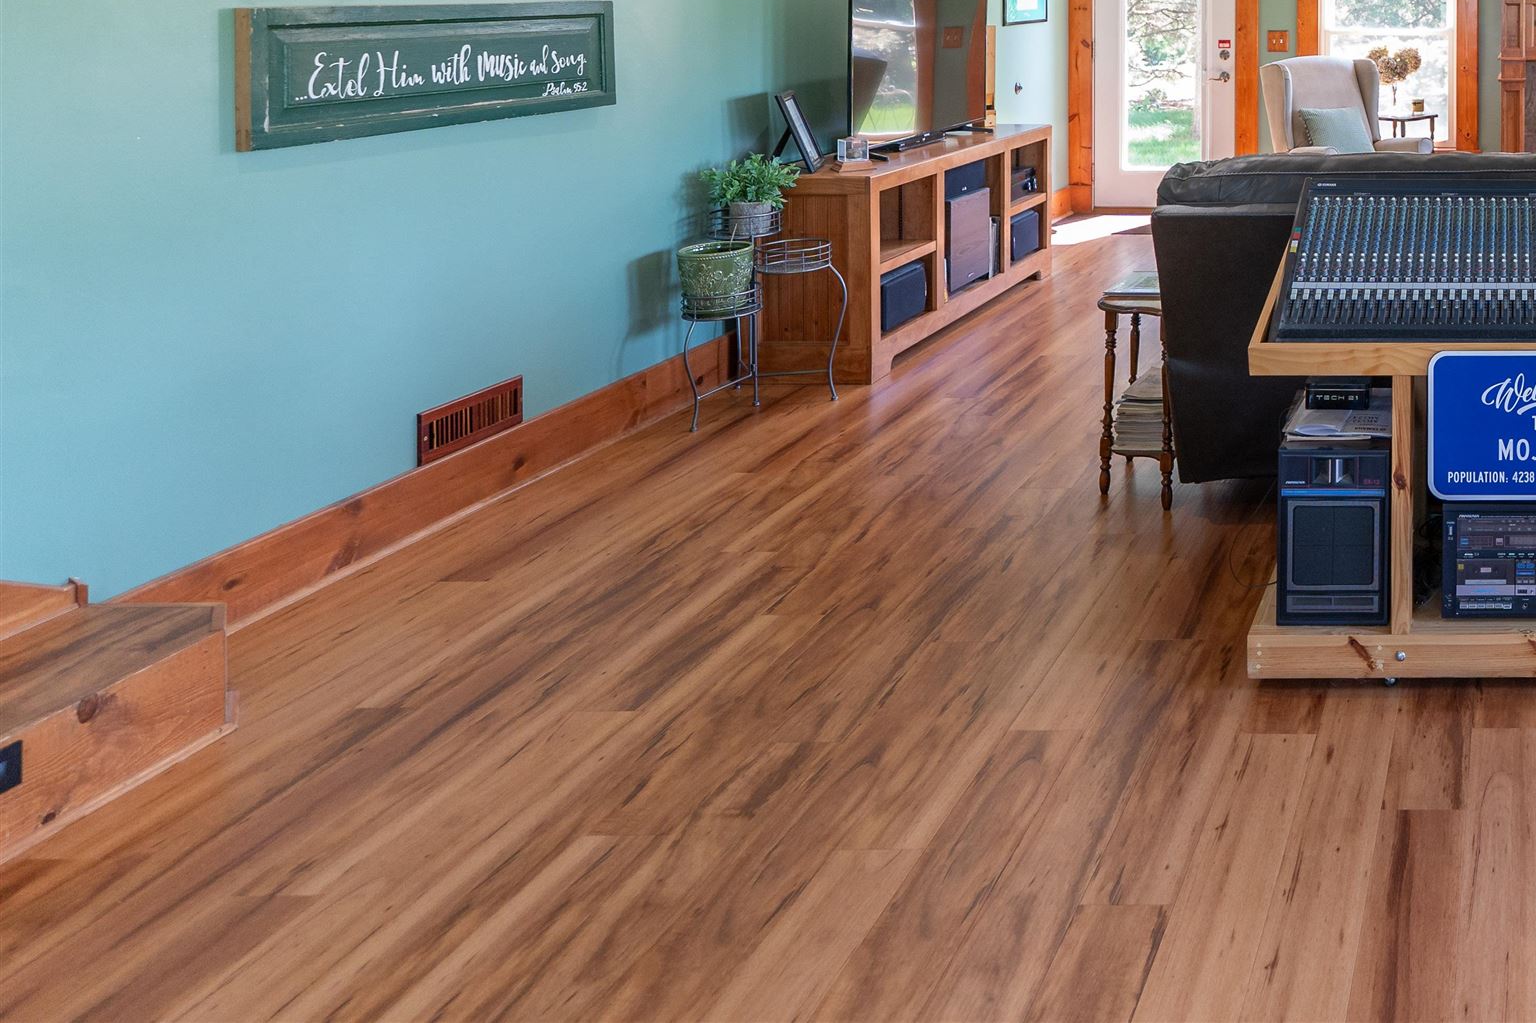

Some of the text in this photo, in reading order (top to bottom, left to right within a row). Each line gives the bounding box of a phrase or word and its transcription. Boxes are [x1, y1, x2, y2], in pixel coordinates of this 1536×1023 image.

[373, 50, 425, 97] Him
[431, 44, 472, 85] with
[529, 44, 549, 75] and
[542, 81, 572, 96] Psalm
[1447, 472, 1535, 483] POPULATION: 4238
